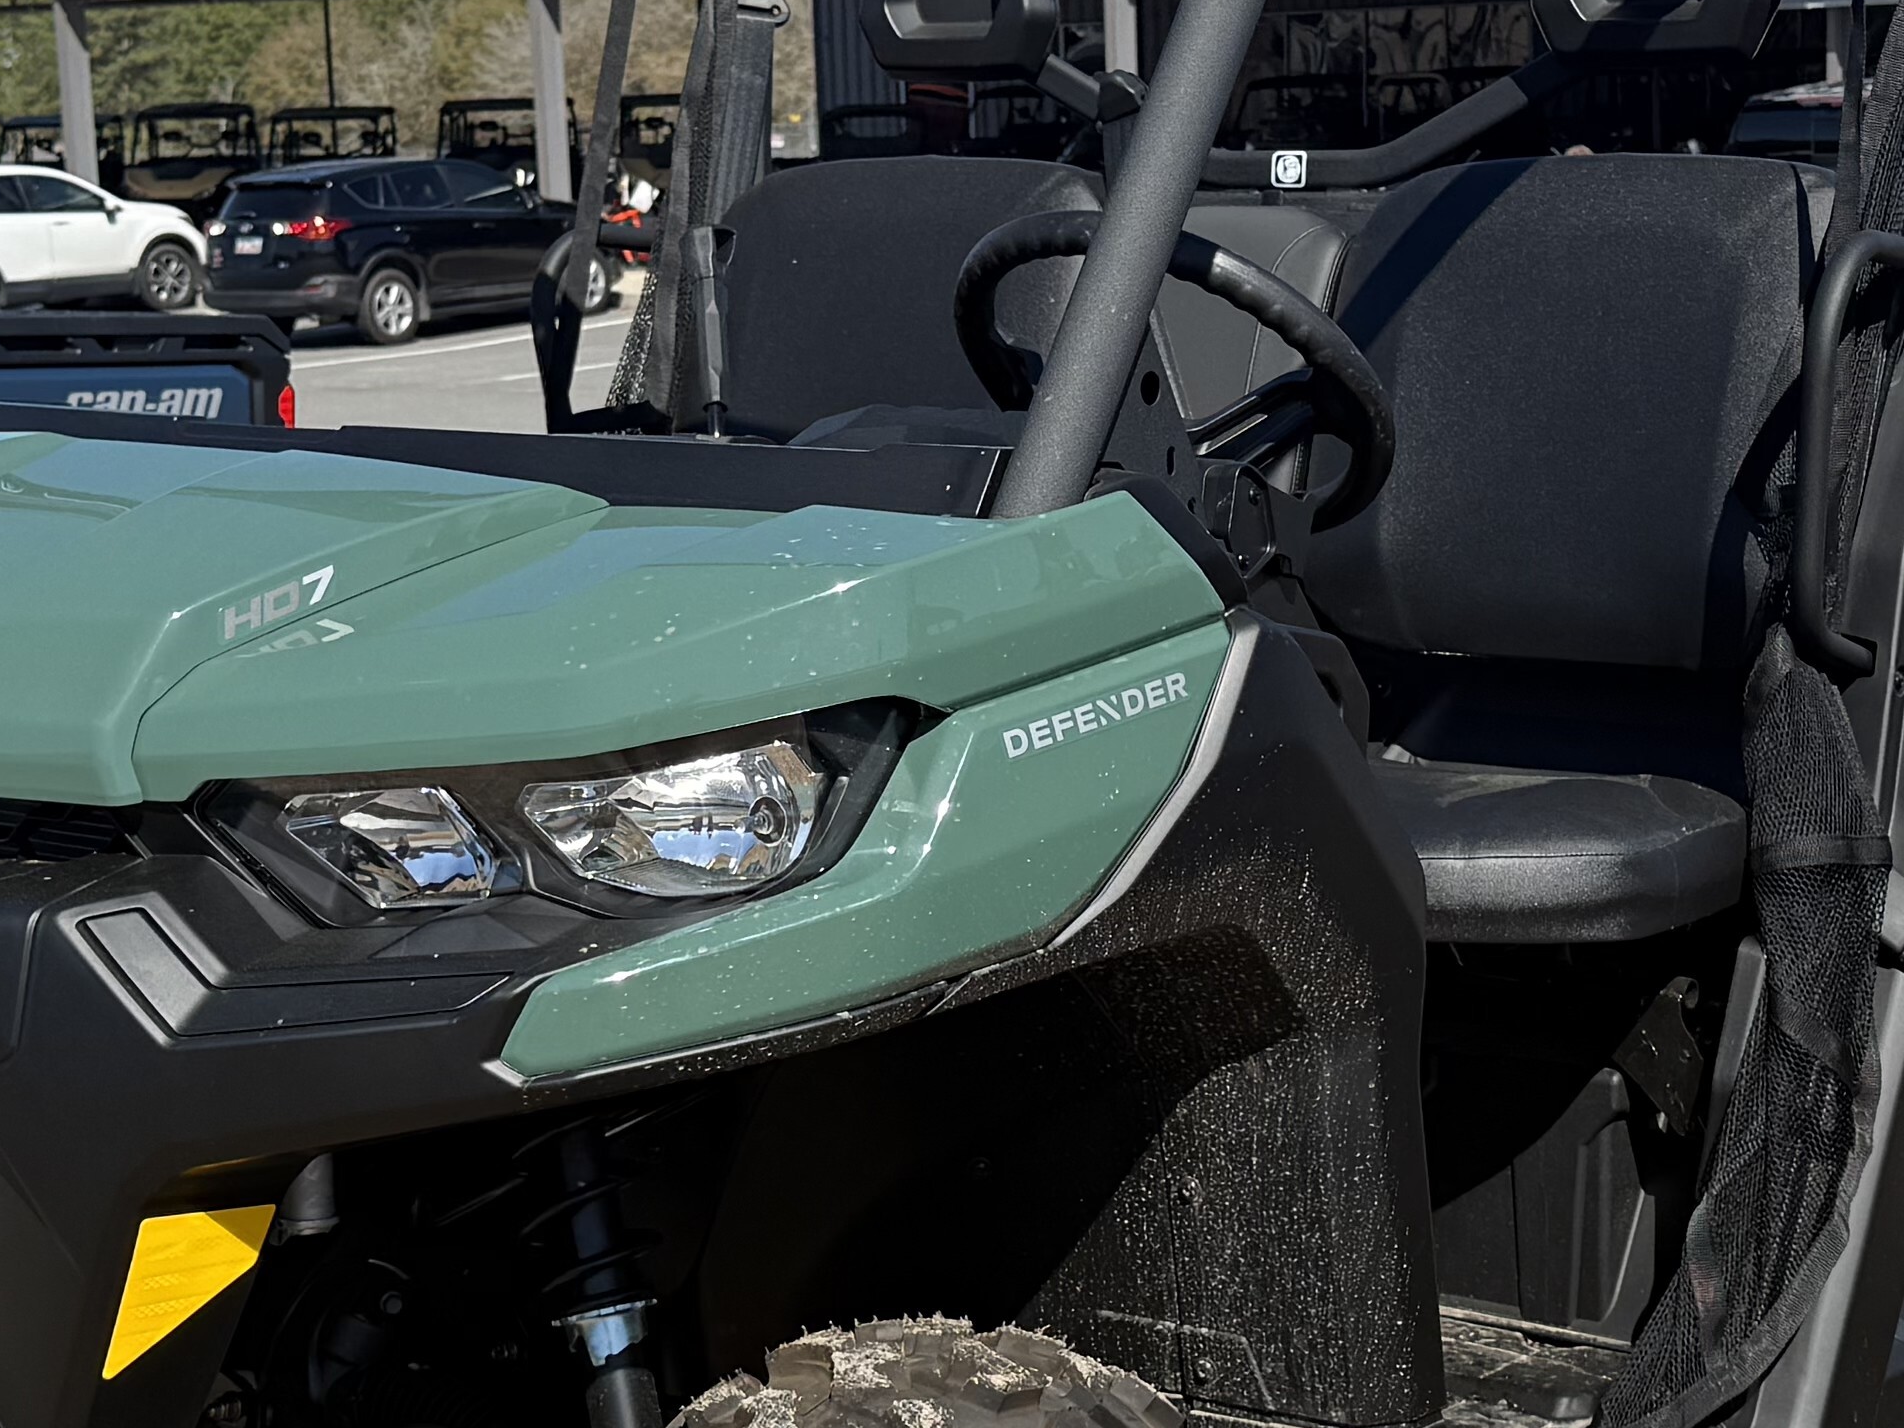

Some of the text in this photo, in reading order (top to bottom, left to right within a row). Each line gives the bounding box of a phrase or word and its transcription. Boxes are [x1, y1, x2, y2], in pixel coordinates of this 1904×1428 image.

[66, 386, 224, 420] can-am
[224, 564, 335, 640] HD7
[1002, 672, 1189, 760] DEFENDER
